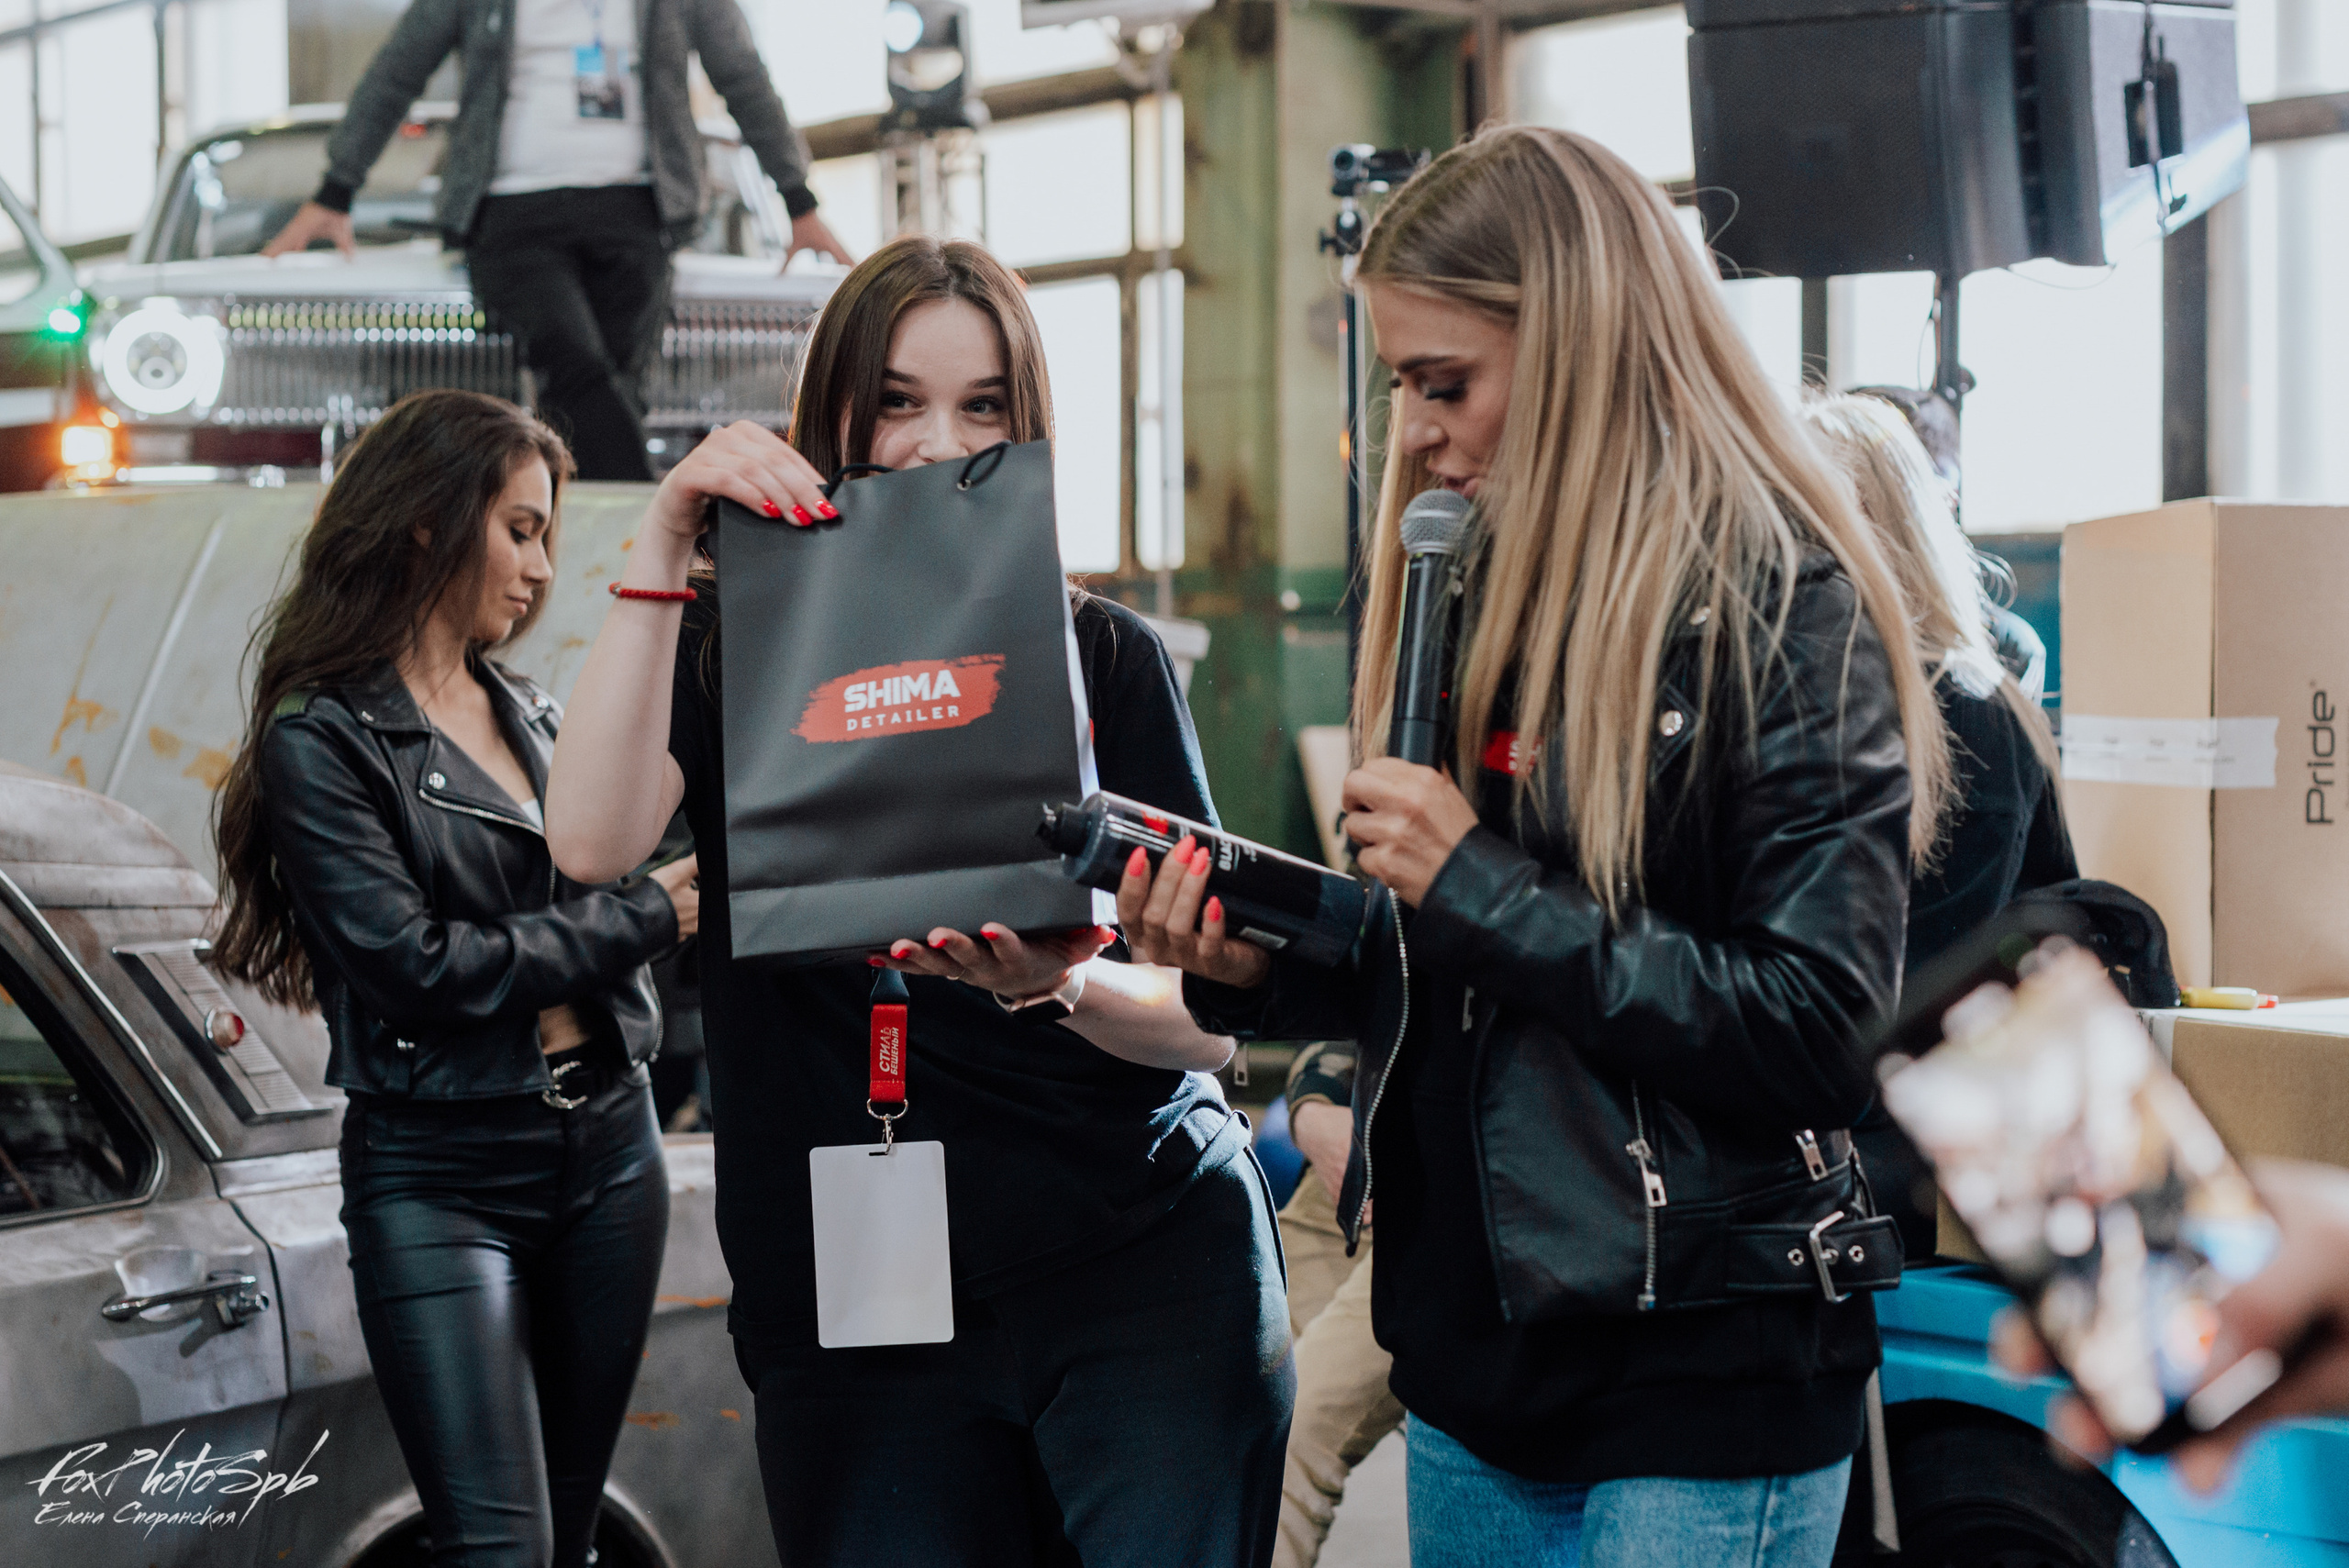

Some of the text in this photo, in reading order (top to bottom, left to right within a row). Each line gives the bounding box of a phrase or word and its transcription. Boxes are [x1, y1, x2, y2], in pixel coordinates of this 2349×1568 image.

[843, 669, 962, 713] SHIMA
[846, 705, 960, 731] DETAILER
[2306, 690, 2335, 825] Pride
